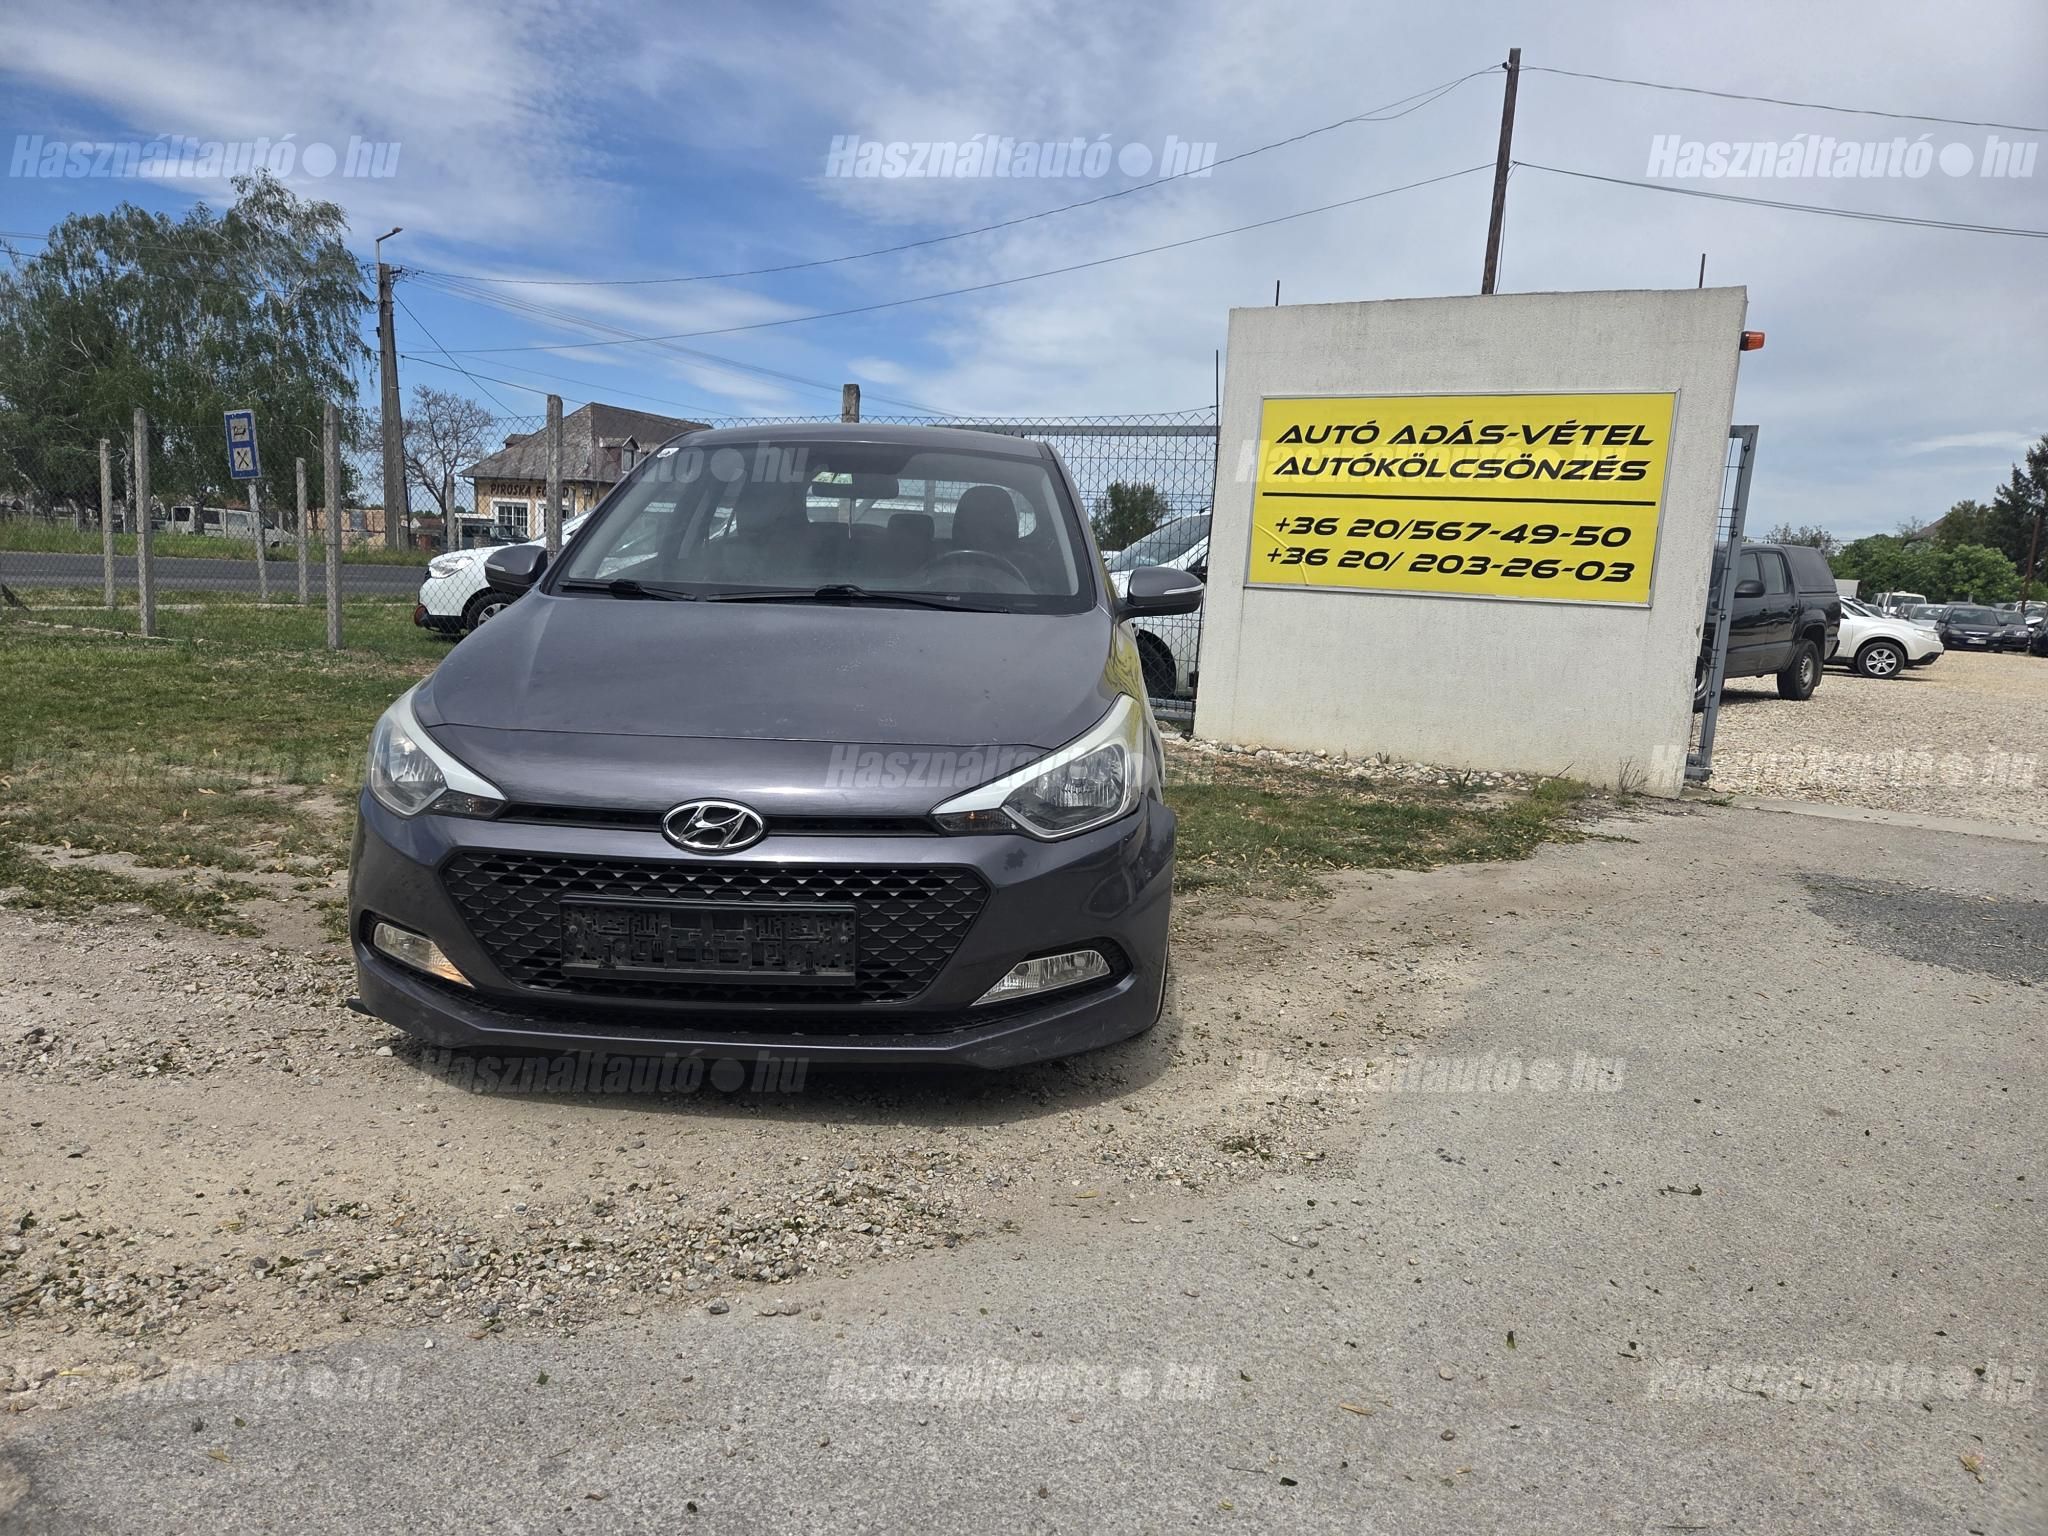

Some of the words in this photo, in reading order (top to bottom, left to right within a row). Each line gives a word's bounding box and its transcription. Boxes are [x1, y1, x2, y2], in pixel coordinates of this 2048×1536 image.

[1276, 421, 1380, 445] AUTÓ
[1387, 420, 1654, 447] ADÁS-VÉTEL
[1274, 452, 1650, 481] AUTÓKÖLCSÖNZÉS
[490, 483, 532, 498] PIROSKA
[1275, 516, 1340, 536] +36
[1347, 518, 1632, 547] 20/567-49-50
[1266, 547, 1328, 566] +36
[1337, 551, 1402, 572] 20/
[1409, 553, 1635, 583] 203-26-03
